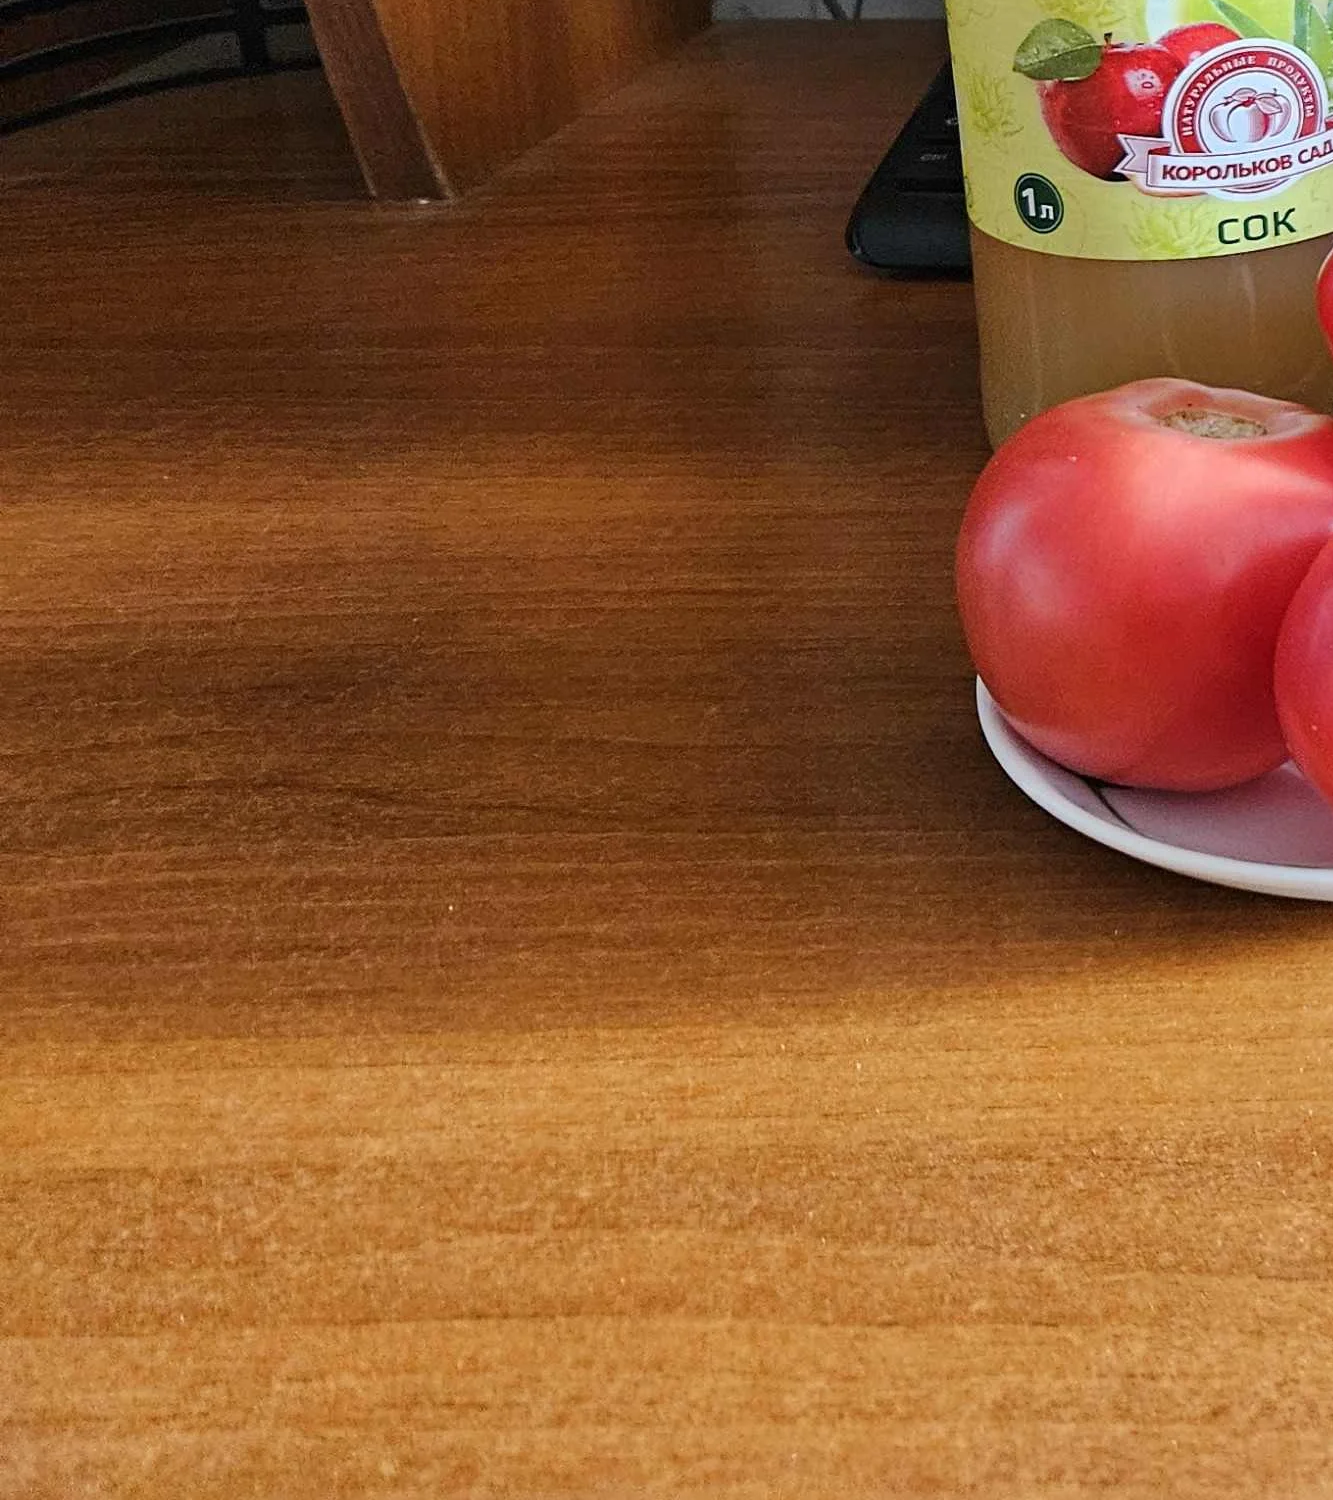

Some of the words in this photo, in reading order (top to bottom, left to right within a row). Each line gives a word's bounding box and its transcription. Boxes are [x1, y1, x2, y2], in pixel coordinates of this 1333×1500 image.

[1181, 55, 1257, 137] НАТУРАЛЬНЫЕ
[1267, 56, 1315, 118] ПРОДУКТЫ
[1161, 154, 1294, 184] КОРОЛЬКОВ
[1217, 207, 1297, 246] СОК
